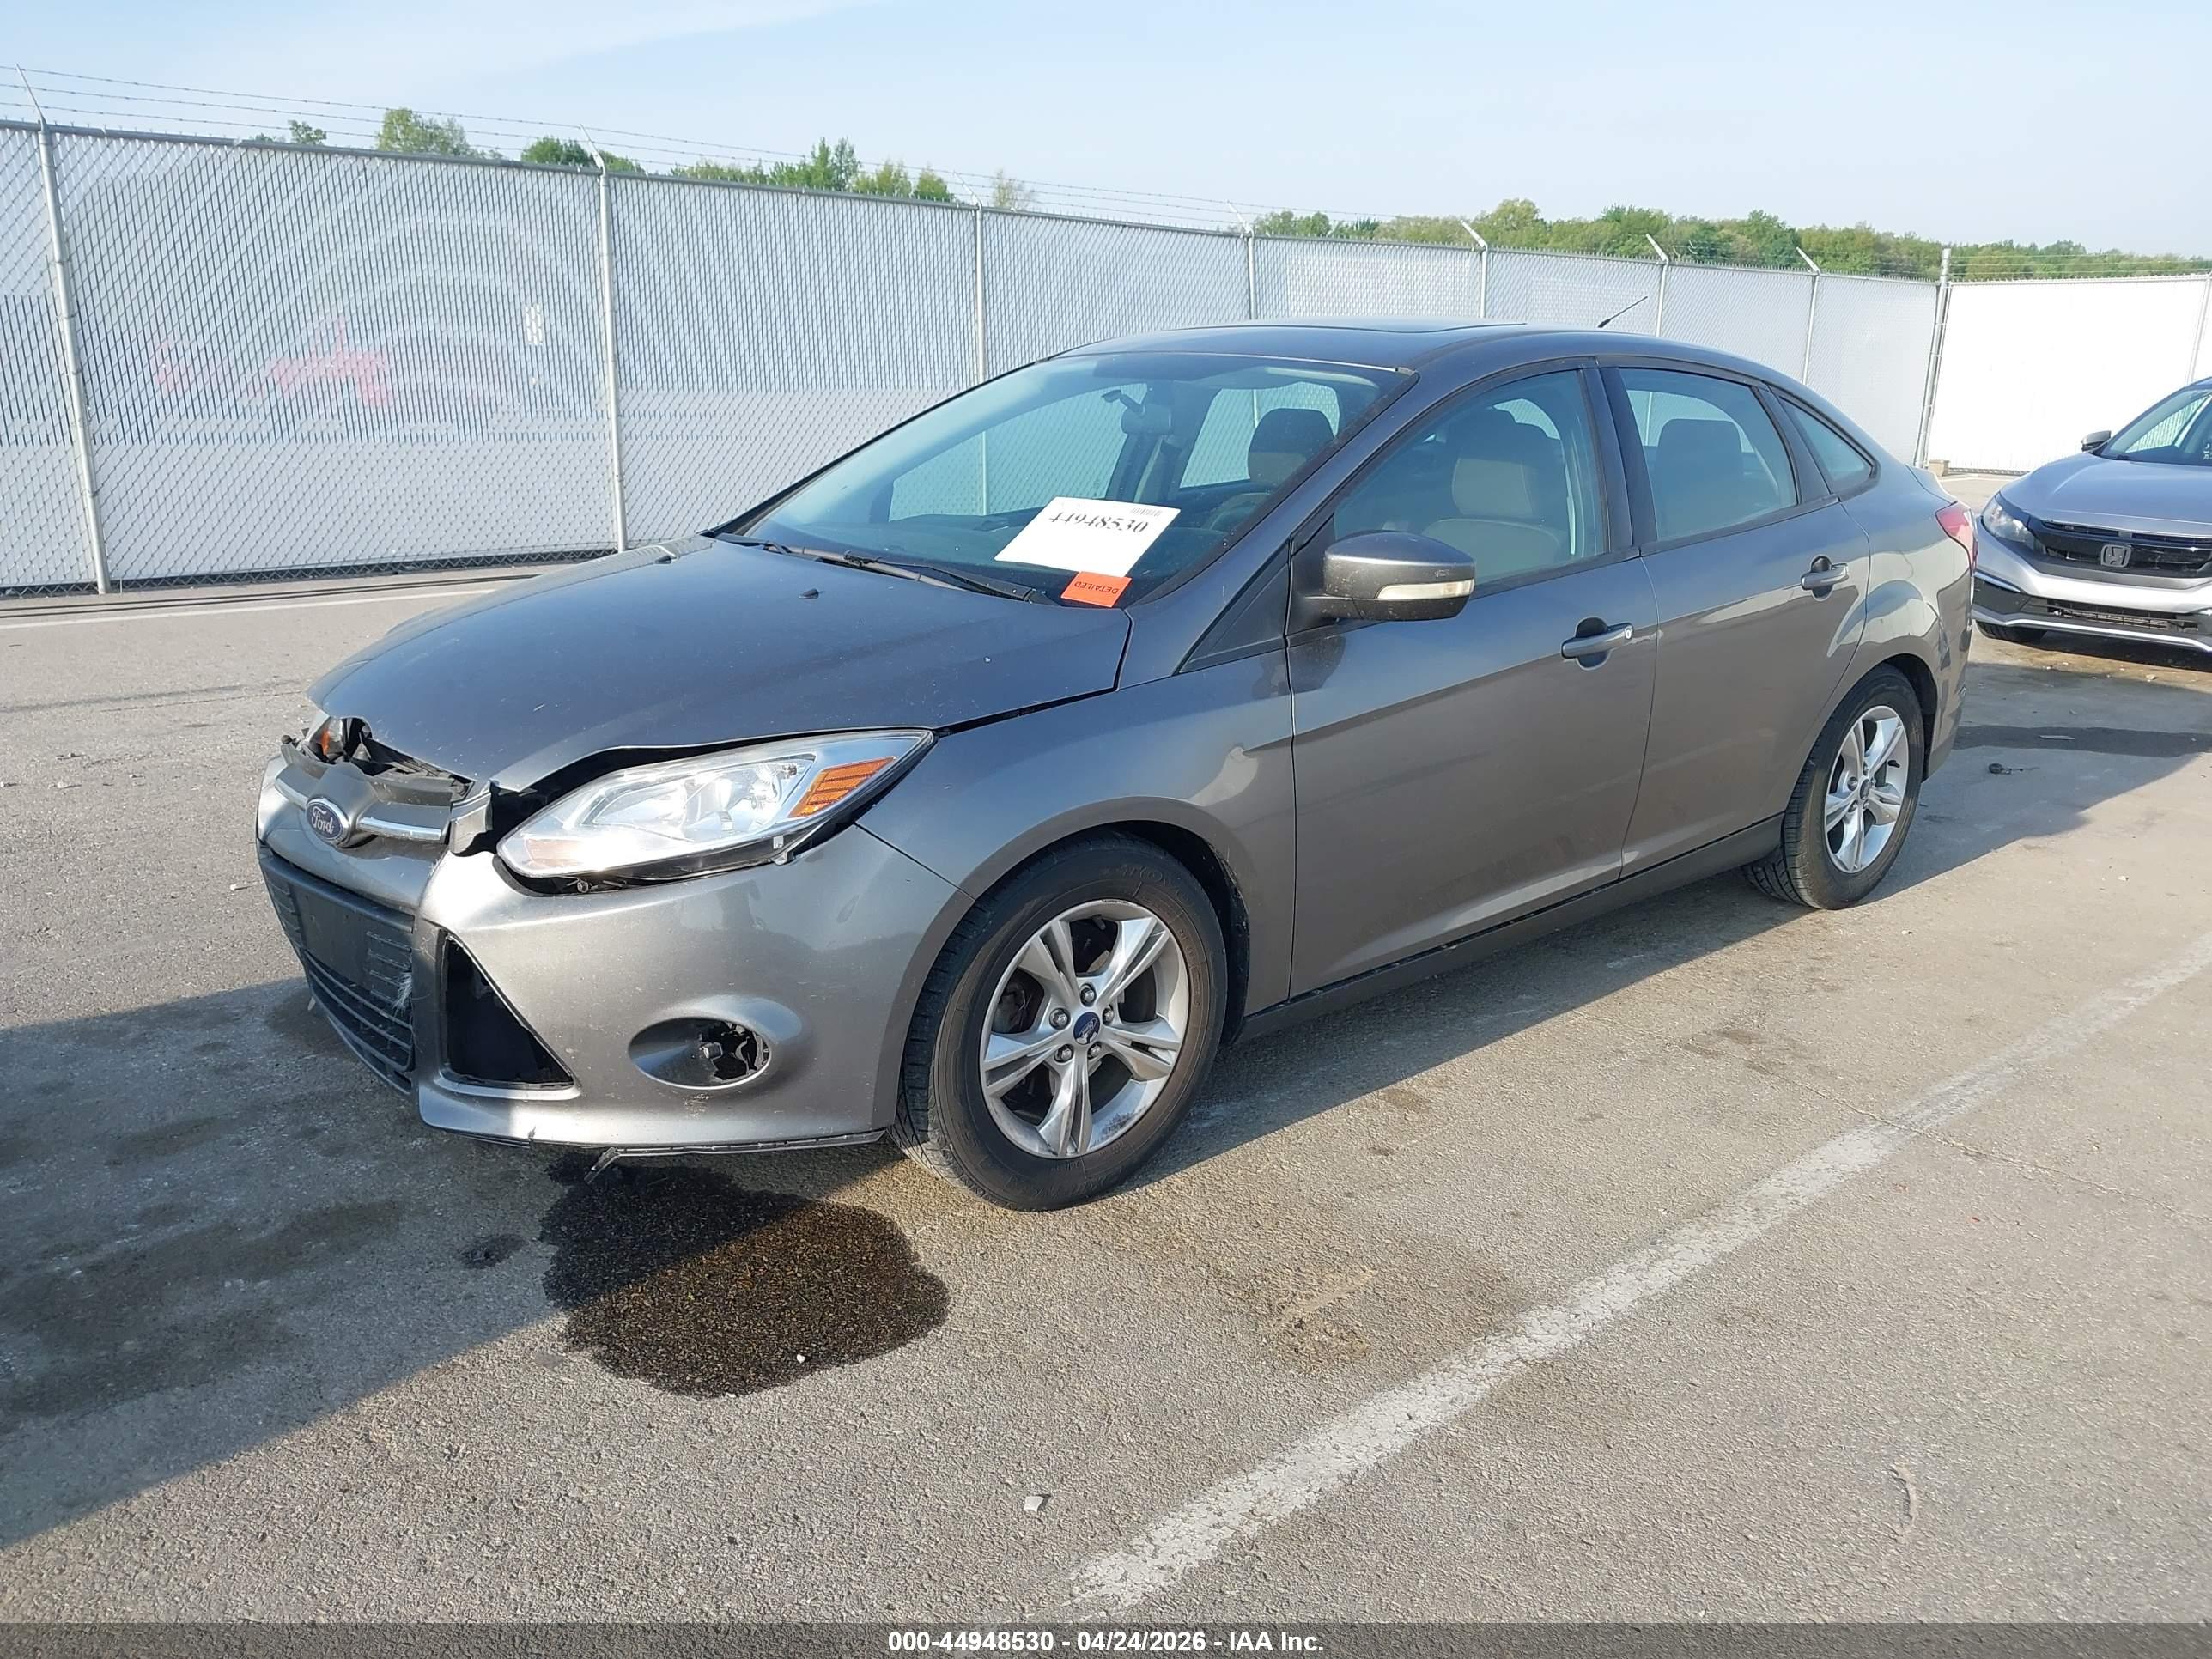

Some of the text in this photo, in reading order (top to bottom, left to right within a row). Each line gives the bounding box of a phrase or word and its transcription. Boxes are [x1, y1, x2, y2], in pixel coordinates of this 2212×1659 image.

[1049, 512, 1149, 533] 44948530
[1073, 580, 1119, 594] DETAILED
[311, 806, 335, 834] Ford
